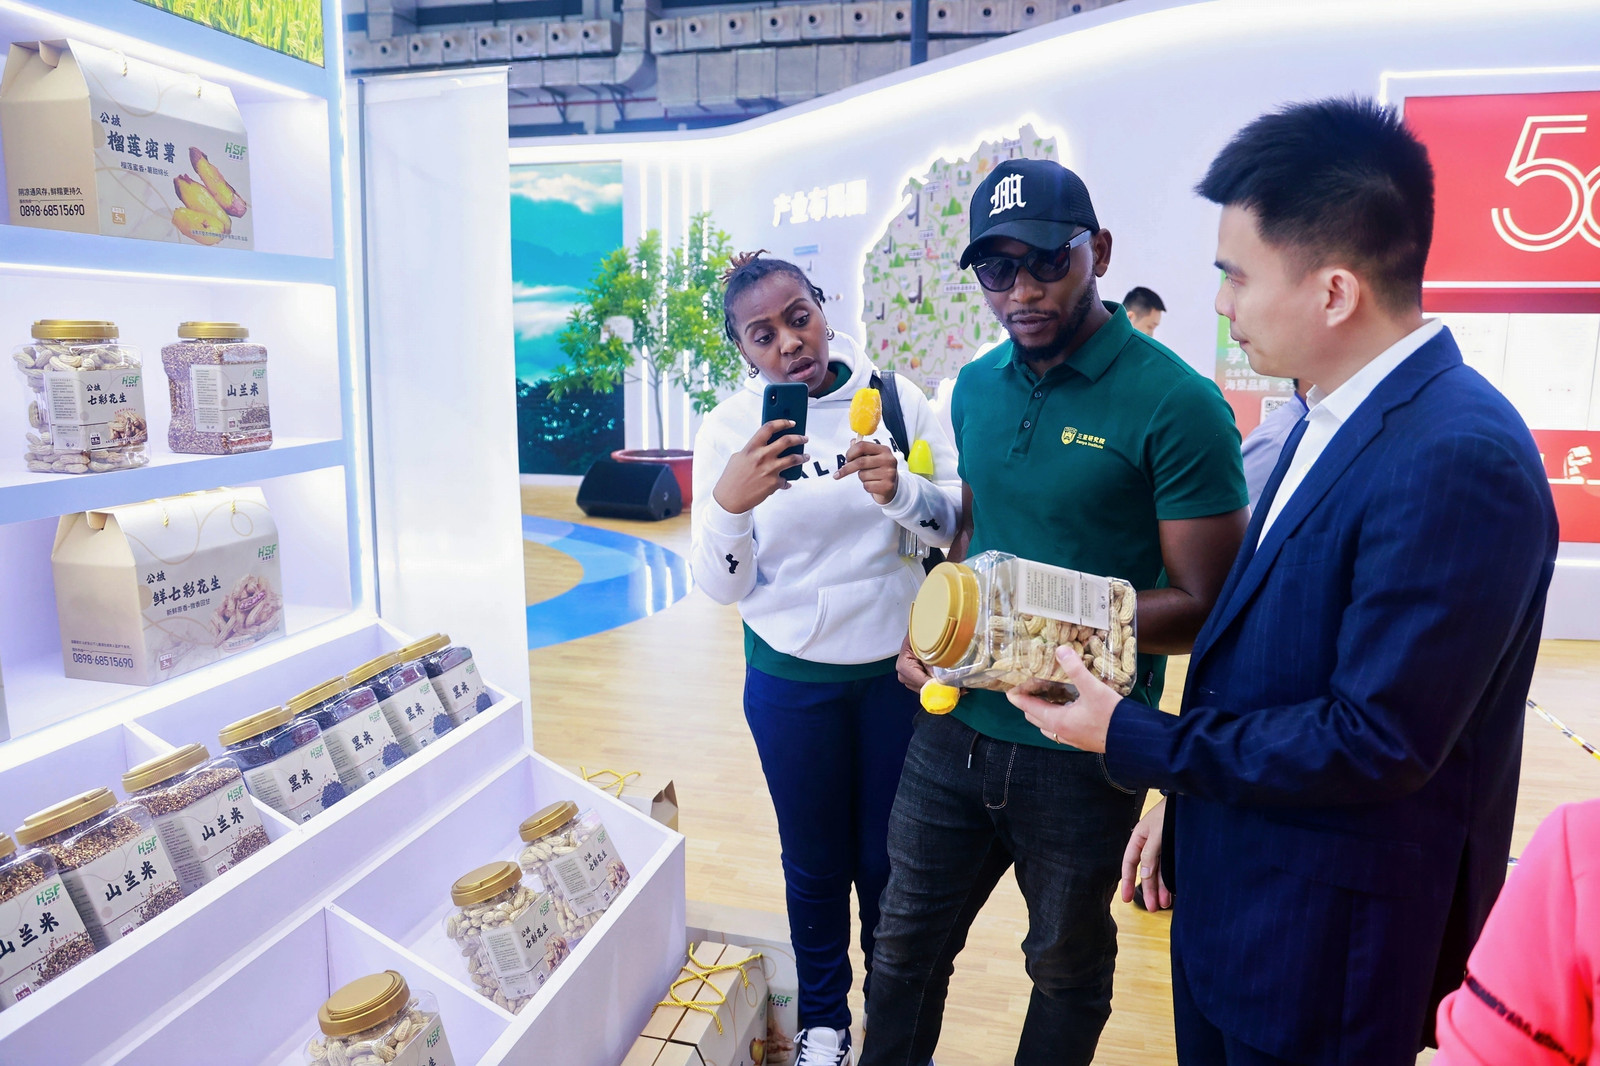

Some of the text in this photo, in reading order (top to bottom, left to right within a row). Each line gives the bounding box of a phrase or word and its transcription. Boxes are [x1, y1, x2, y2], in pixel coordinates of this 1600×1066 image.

[100, 112, 121, 127] 公坡
[107, 130, 175, 163] 榴莲密薯
[225, 142, 247, 156] HSF
[1490, 114, 1600, 252] 5
[122, 376, 140, 385] HSF
[227, 382, 259, 397] 山兰米
[88, 392, 127, 406] 七彩花生
[258, 544, 277, 558] HSF
[146, 570, 166, 584] 公坡
[153, 575, 222, 607] 鲜七彩花生
[452, 681, 470, 699] 黑米
[405, 702, 425, 721] 黑米
[351, 731, 374, 751] 黑米
[310, 745, 324, 758] HSF
[288, 769, 313, 792] 黑米
[227, 785, 244, 801] HSF
[202, 807, 244, 841] 山兰米
[138, 836, 157, 855] HSF
[588, 849, 607, 872] 七彩花生
[105, 860, 157, 901] 山兰米
[36, 883, 61, 905] HSF
[0, 912, 59, 960] 山兰米
[525, 923, 549, 949] 七彩花生
[768, 993, 792, 1004] HSF
[426, 1026, 441, 1048] HSF
